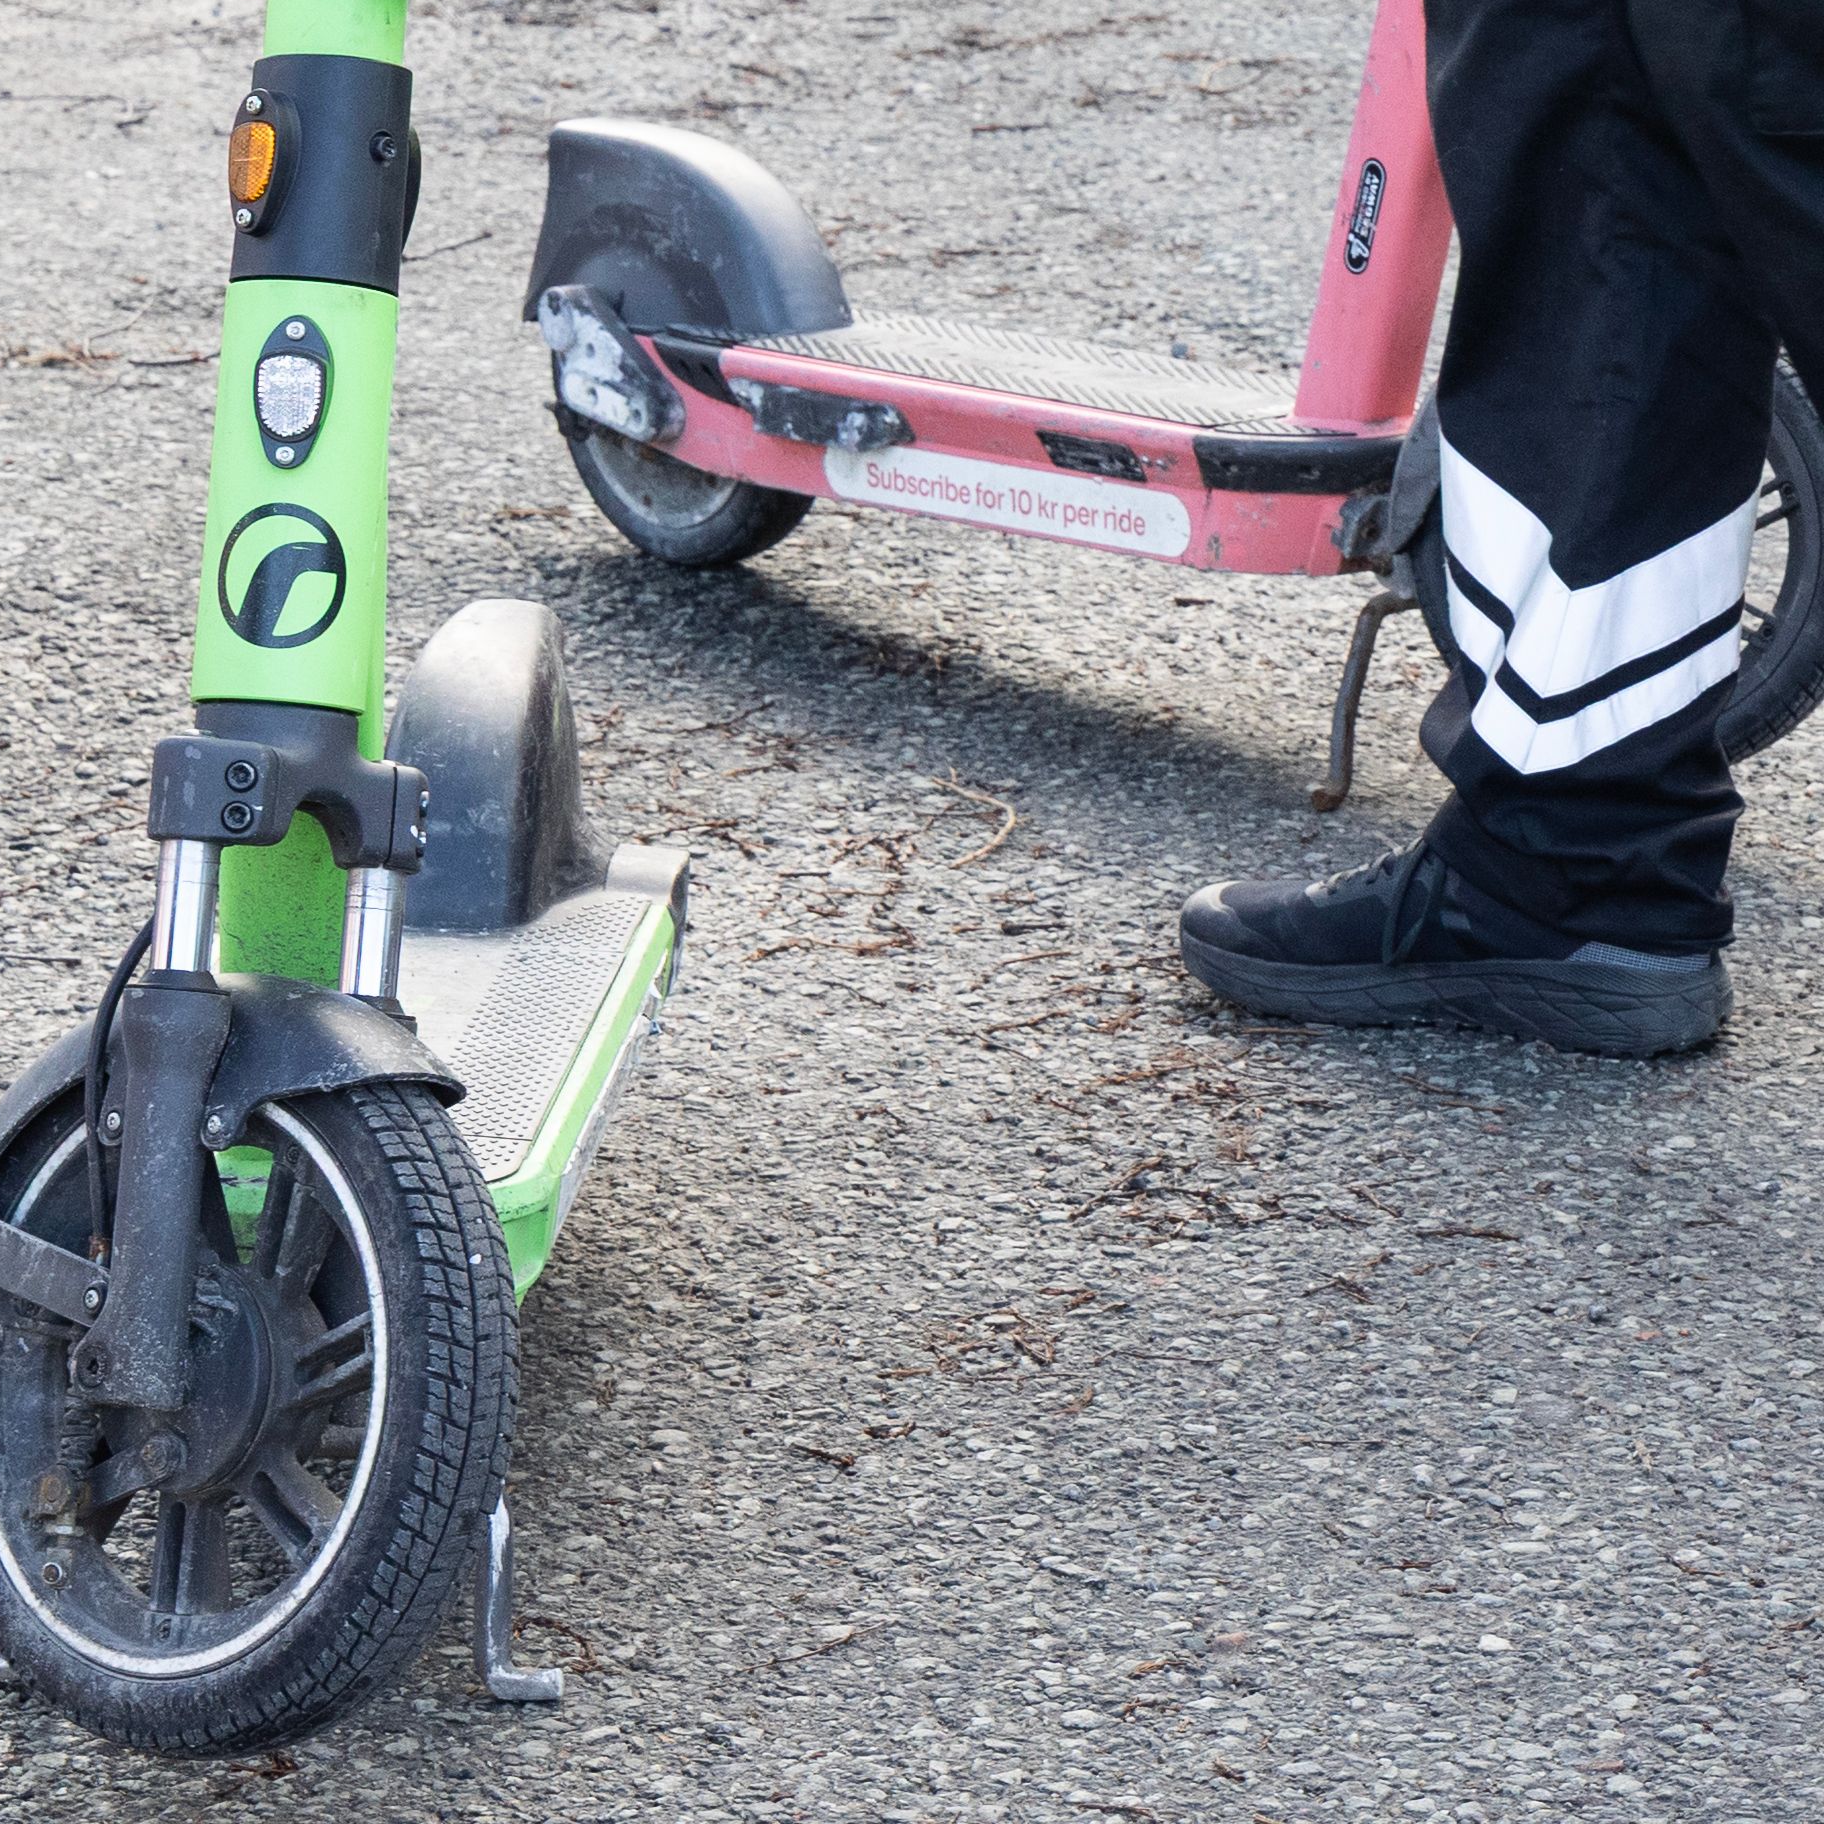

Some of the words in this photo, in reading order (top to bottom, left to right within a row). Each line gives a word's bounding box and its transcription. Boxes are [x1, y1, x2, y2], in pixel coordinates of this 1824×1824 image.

[866, 462, 971, 505] Subscribe
[975, 481, 1005, 511] for
[1008, 488, 1033, 516] 10
[1037, 493, 1059, 521] kr
[1062, 502, 1099, 528] per
[1102, 504, 1147, 537] ride
